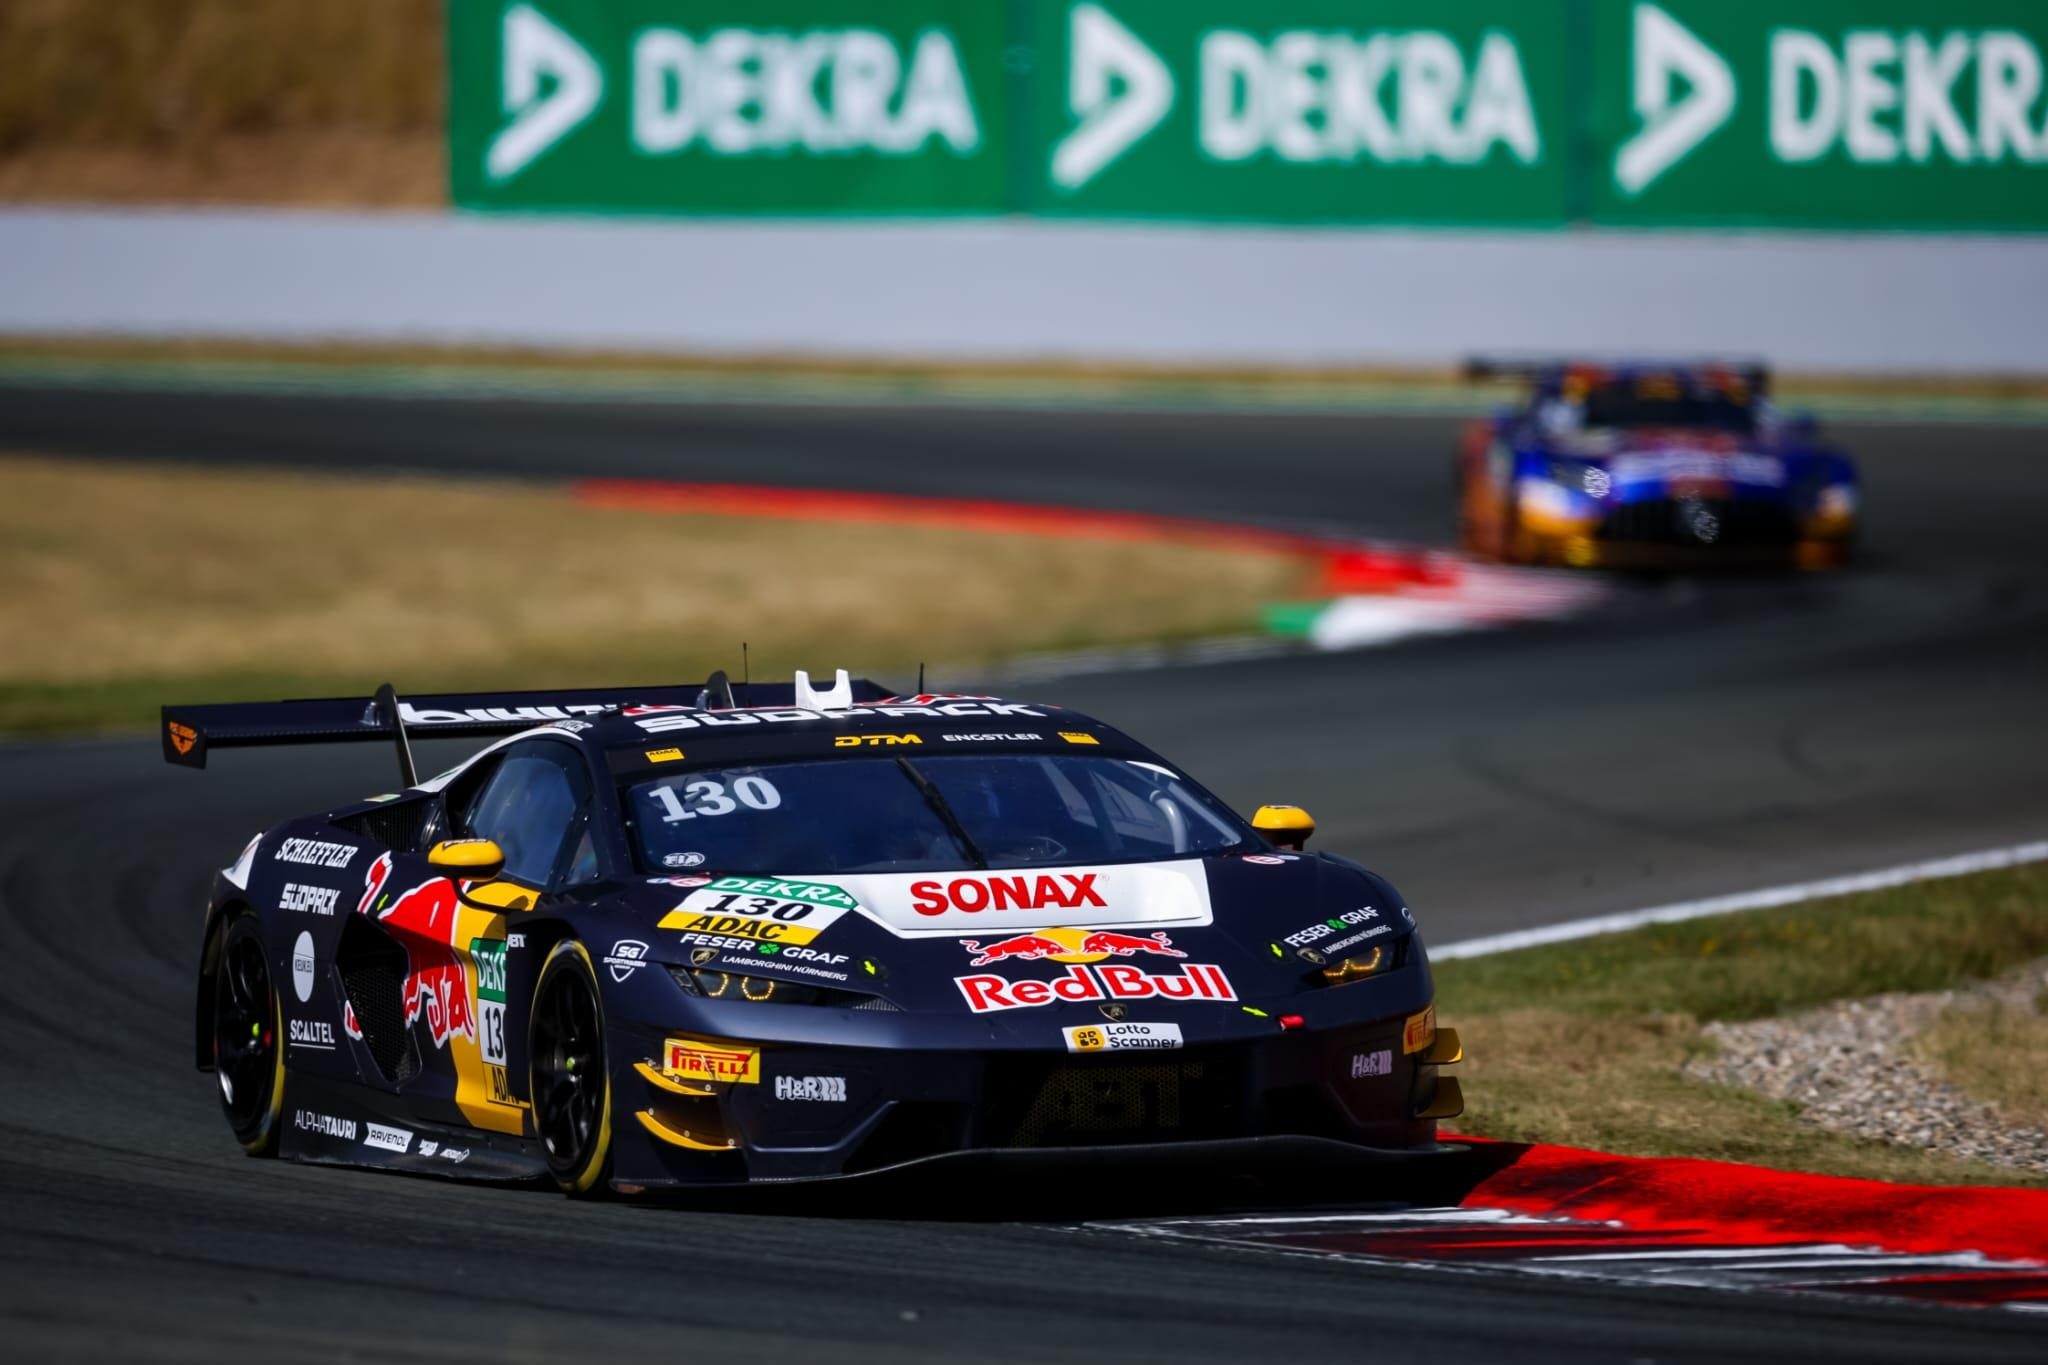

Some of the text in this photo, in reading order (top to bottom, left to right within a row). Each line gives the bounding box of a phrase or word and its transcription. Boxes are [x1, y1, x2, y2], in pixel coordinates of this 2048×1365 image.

[632, 28, 979, 153] DEKRA
[1199, 29, 1539, 162] DEKRA
[834, 734, 923, 748] DTM
[942, 733, 1043, 743] ENGSTLER
[649, 776, 782, 823] 130
[274, 837, 359, 868] SCHAEFFLER
[663, 854, 702, 866] FIA
[714, 877, 852, 906] DEKRA
[910, 873, 1108, 916] SONAX
[704, 894, 814, 922] 130
[685, 915, 788, 940] ADAC
[1284, 905, 1380, 947] FESER GRAF
[505, 933, 527, 951] ABT
[616, 946, 641, 959] SG
[680, 933, 849, 966] FESER GRAF
[470, 949, 507, 993] DEK
[722, 954, 849, 981] LAMBORGHINI NÜRNBERG
[954, 963, 1239, 1013] Red Bull
[289, 1018, 336, 1045] SCALTEL
[484, 1006, 505, 1060] 13
[1108, 1025, 1151, 1036] Lotto
[1109, 1037, 1176, 1049] Scanner
[671, 1047, 749, 1076] PIRELLI
[775, 1076, 821, 1101] H&R
[294, 1109, 357, 1141] ALPHATAURI
[370, 1129, 407, 1148] RAVENOL
